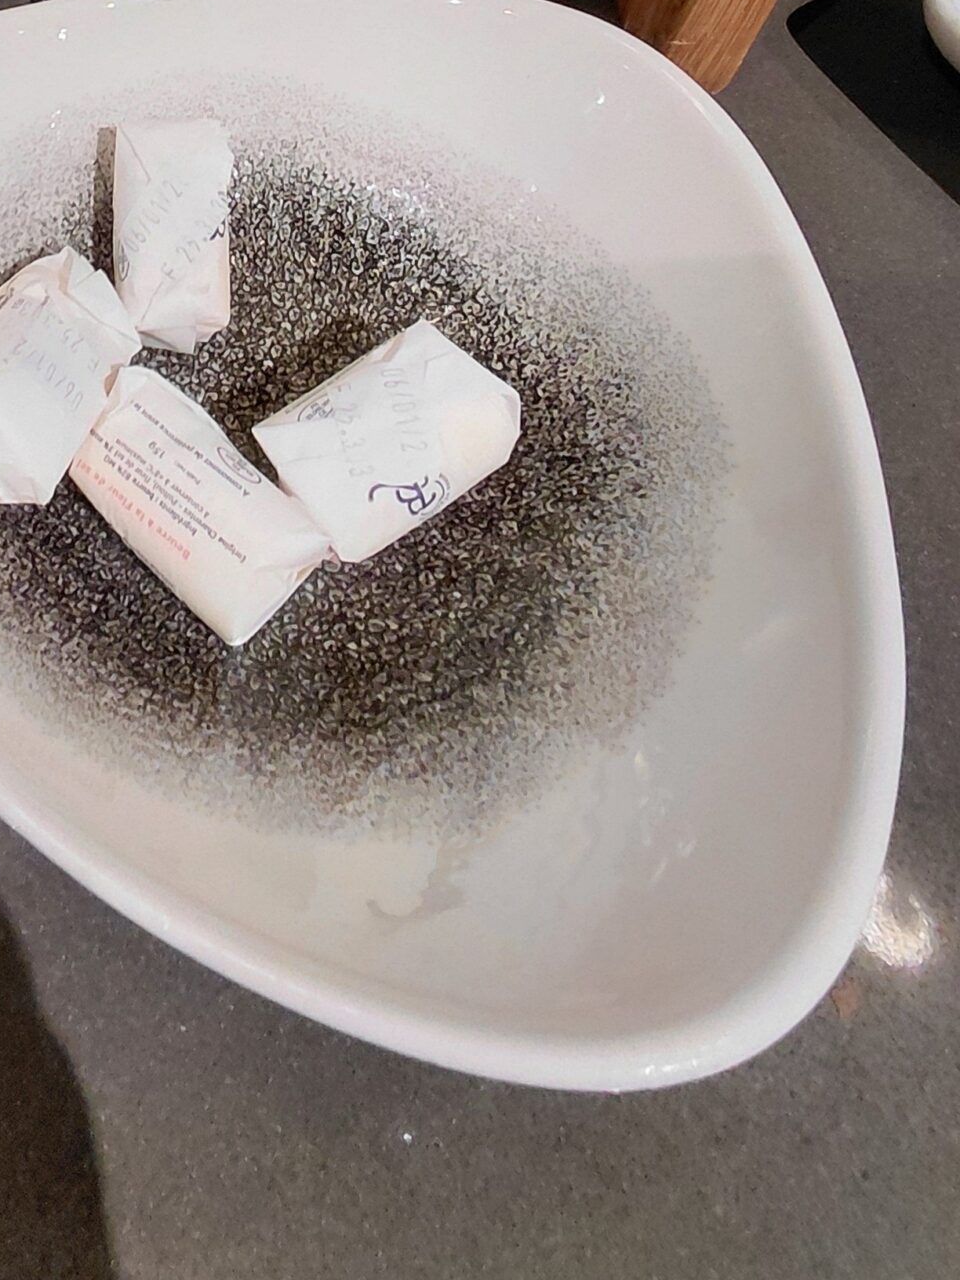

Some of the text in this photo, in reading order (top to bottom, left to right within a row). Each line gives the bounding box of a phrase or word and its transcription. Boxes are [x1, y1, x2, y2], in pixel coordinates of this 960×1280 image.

[148, 440, 167, 459] 15g
[94, 473, 106, 485] de
[109, 484, 134, 511] Fleur
[156, 527, 191, 560] Beurre
